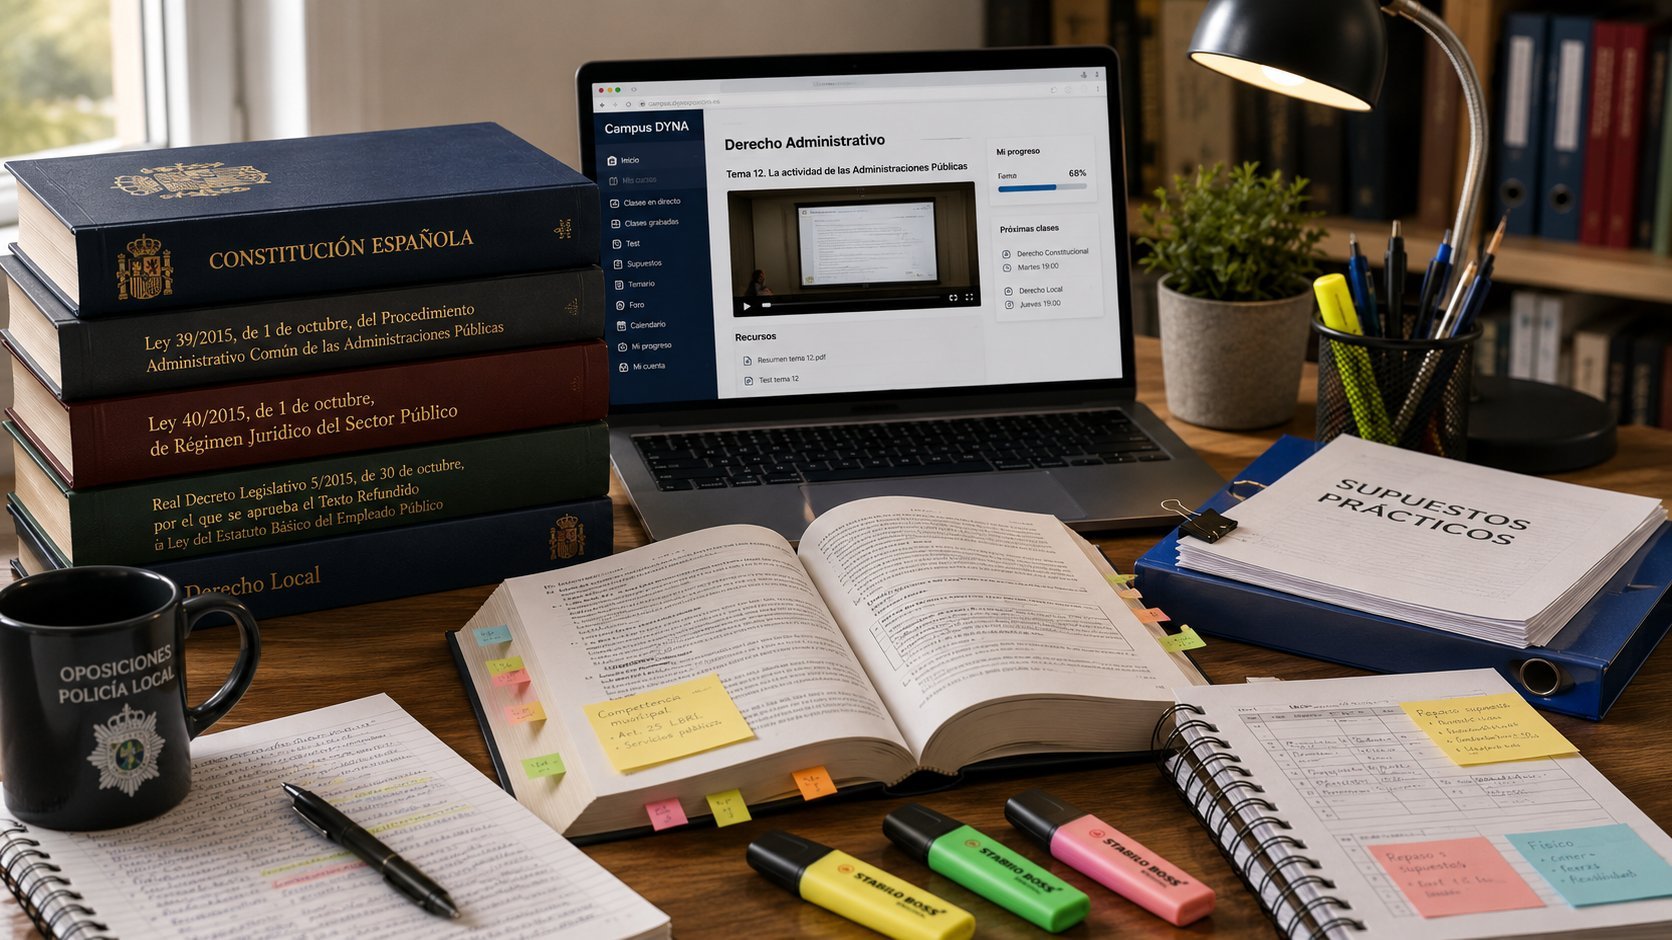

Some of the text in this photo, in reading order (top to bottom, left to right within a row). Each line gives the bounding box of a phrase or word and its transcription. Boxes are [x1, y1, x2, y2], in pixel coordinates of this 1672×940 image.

[605, 121, 689, 135] Campus DYNA
[725, 133, 885, 150] Derecho Administrativo
[726, 170, 751, 178] Tema
[753, 169, 766, 177] 12.
[781, 167, 822, 176] actividad
[824, 167, 835, 175] de
[837, 166, 850, 174] las
[852, 164, 929, 174] Administraciones
[931, 162, 967, 170] Públicas
[209, 228, 473, 269] CONSTITUCIÓN ESPAÑOLA
[1044, 248, 1088, 256] Constitucional
[145, 305, 474, 352] Ley 39/2015, de 1 de octubre, del Procedimiento
[146, 322, 504, 372] Administrativo Común de las Administraciones Públicas
[148, 392, 374, 433] Ley 40/2015, de 1 de octubre,
[150, 440, 168, 456] de
[174, 435, 242, 455] Régimen
[316, 417, 340, 434] del
[345, 414, 394, 431] Sector
[401, 404, 457, 424] Público
[152, 458, 464, 510] Real Decreto Legislativo 5/2015, de 30 de octubre,
[154, 483, 419, 534] por el que se aprueba el Texto Refundido
[167, 537, 189, 549] Ley
[193, 531, 211, 545] del
[216, 526, 266, 542] Estatuto
[271, 519, 310, 534] Básico
[315, 513, 332, 527] del
[337, 505, 395, 524] Empleado
[400, 499, 443, 514] Público
[1317, 493, 1516, 546] PRÁCTICOS
[1336, 479, 1531, 531] SUPUESTOS
[271, 565, 320, 590] Local
[60, 645, 172, 682] OPOSICIONES
[59, 666, 175, 704] POLICÍA LOCAL
